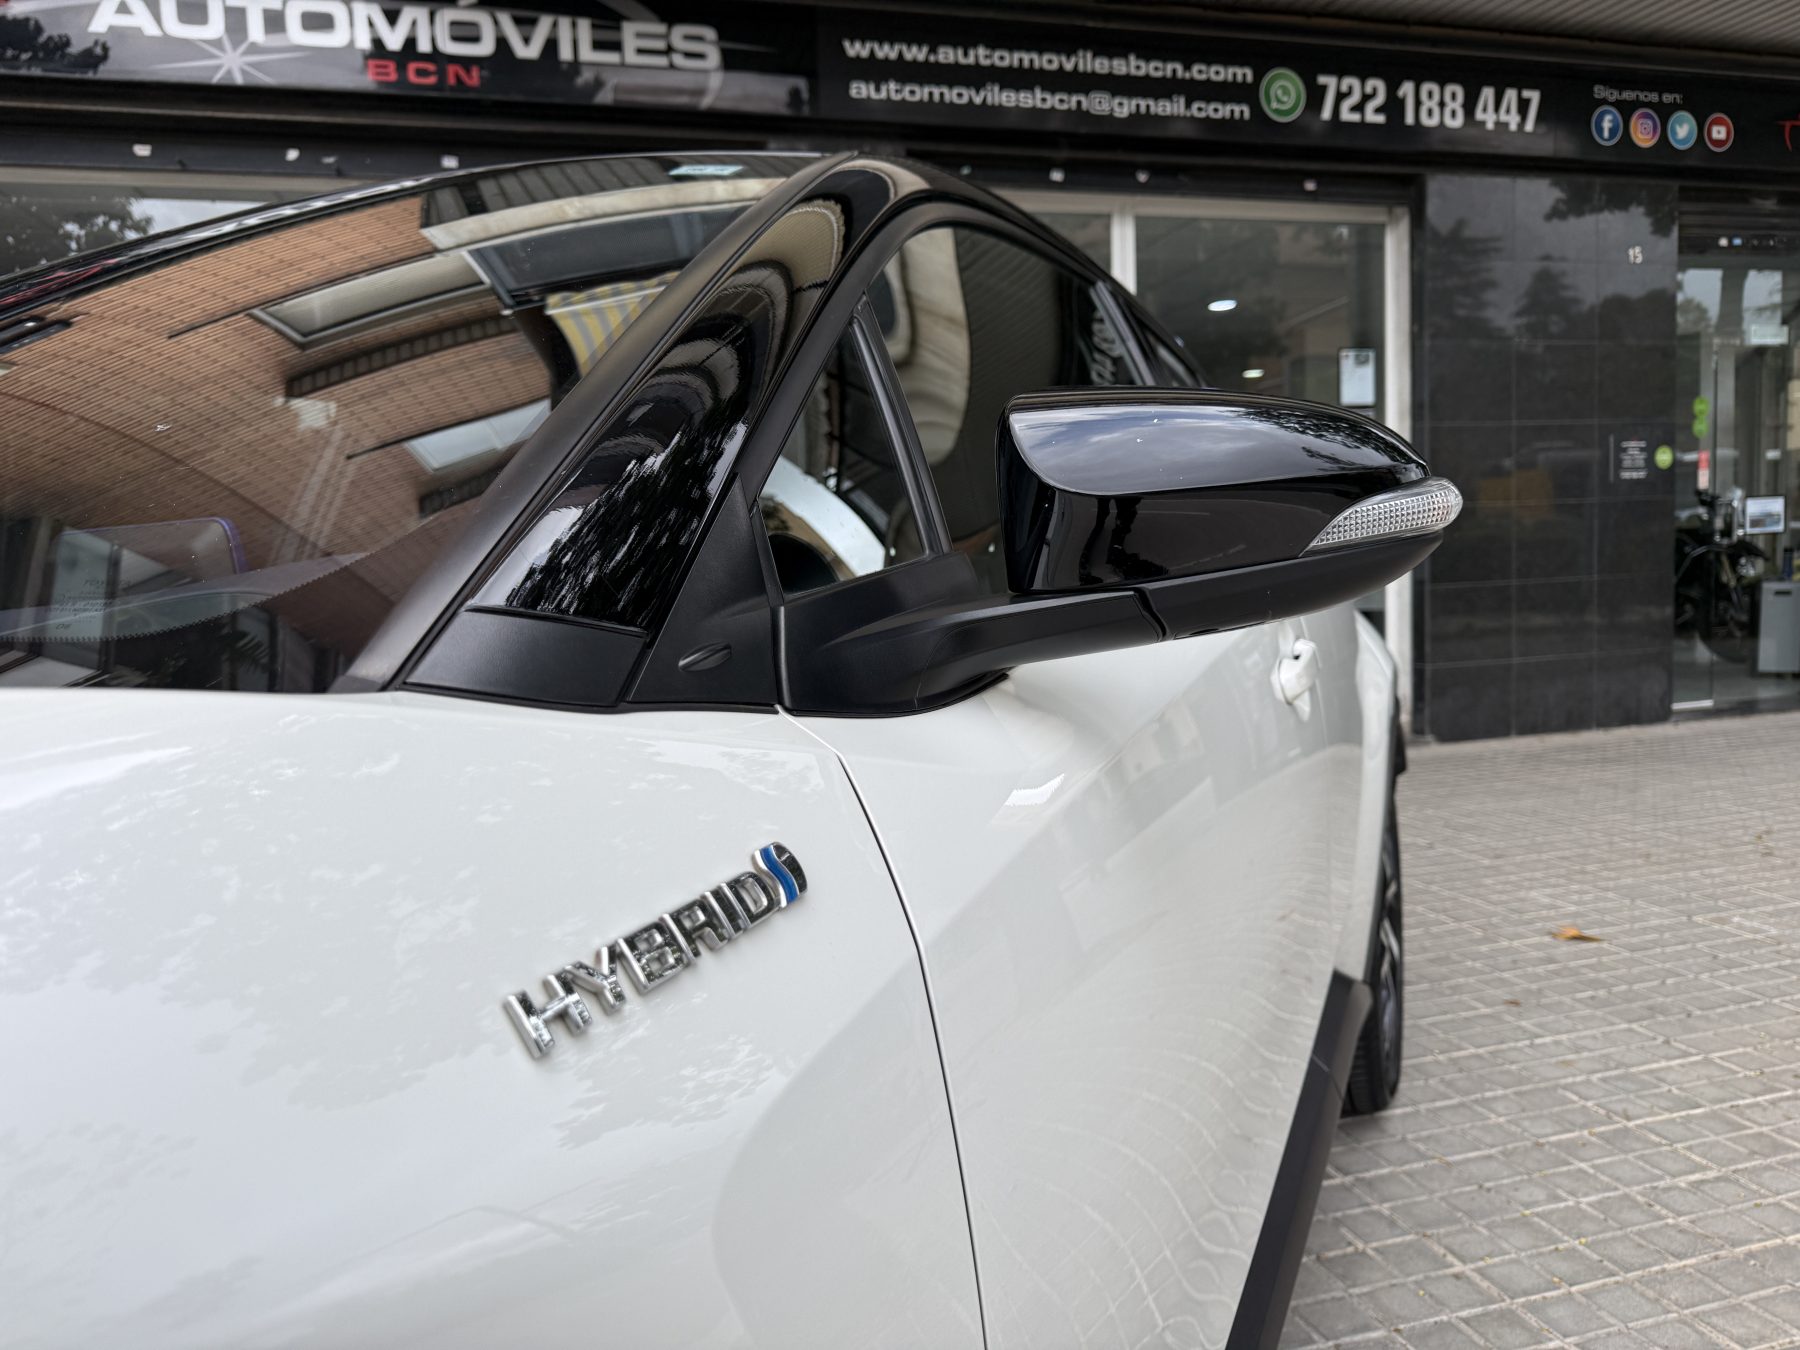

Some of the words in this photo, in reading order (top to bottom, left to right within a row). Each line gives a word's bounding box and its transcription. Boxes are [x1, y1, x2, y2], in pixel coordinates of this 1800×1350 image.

[366, 58, 481, 87] BCN
[843, 37, 1254, 84] www.automovilesbcn.com
[849, 78, 1251, 121] automovilesbcn@gmail.com
[1317, 75, 1388, 124] 722
[1397, 81, 1465, 129] 188
[1474, 86, 1541, 133] 447
[1628, 246, 1643, 264] 15
[503, 870, 781, 1060] HYBRID
